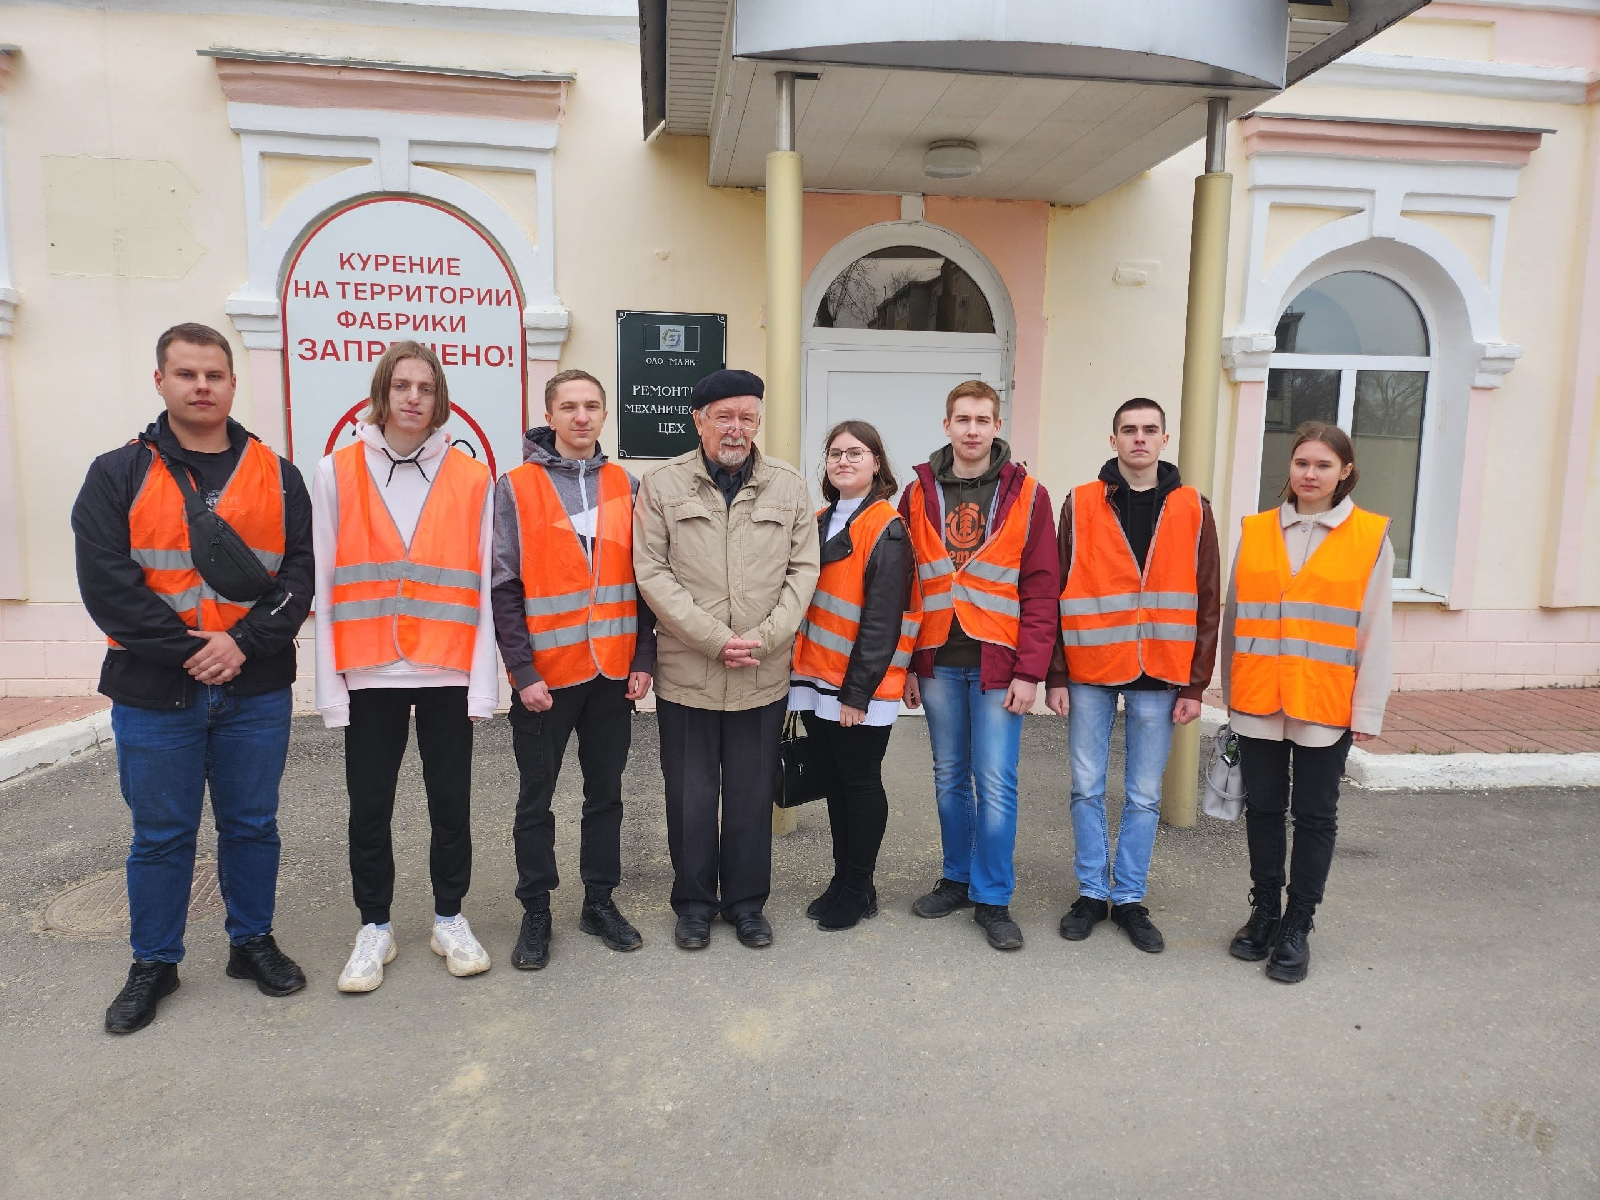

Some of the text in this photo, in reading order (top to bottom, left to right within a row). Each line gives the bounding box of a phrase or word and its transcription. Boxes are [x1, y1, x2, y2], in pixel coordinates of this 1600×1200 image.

[339, 252, 461, 277] КУРЕНИЕ
[294, 280, 512, 307] НА ТЕРРИТОРИИ
[336, 310, 466, 333] ФАБРИКИ
[297, 338, 514, 368] ЗАПРЕНО!
[658, 422, 686, 435] ЦЕХ
